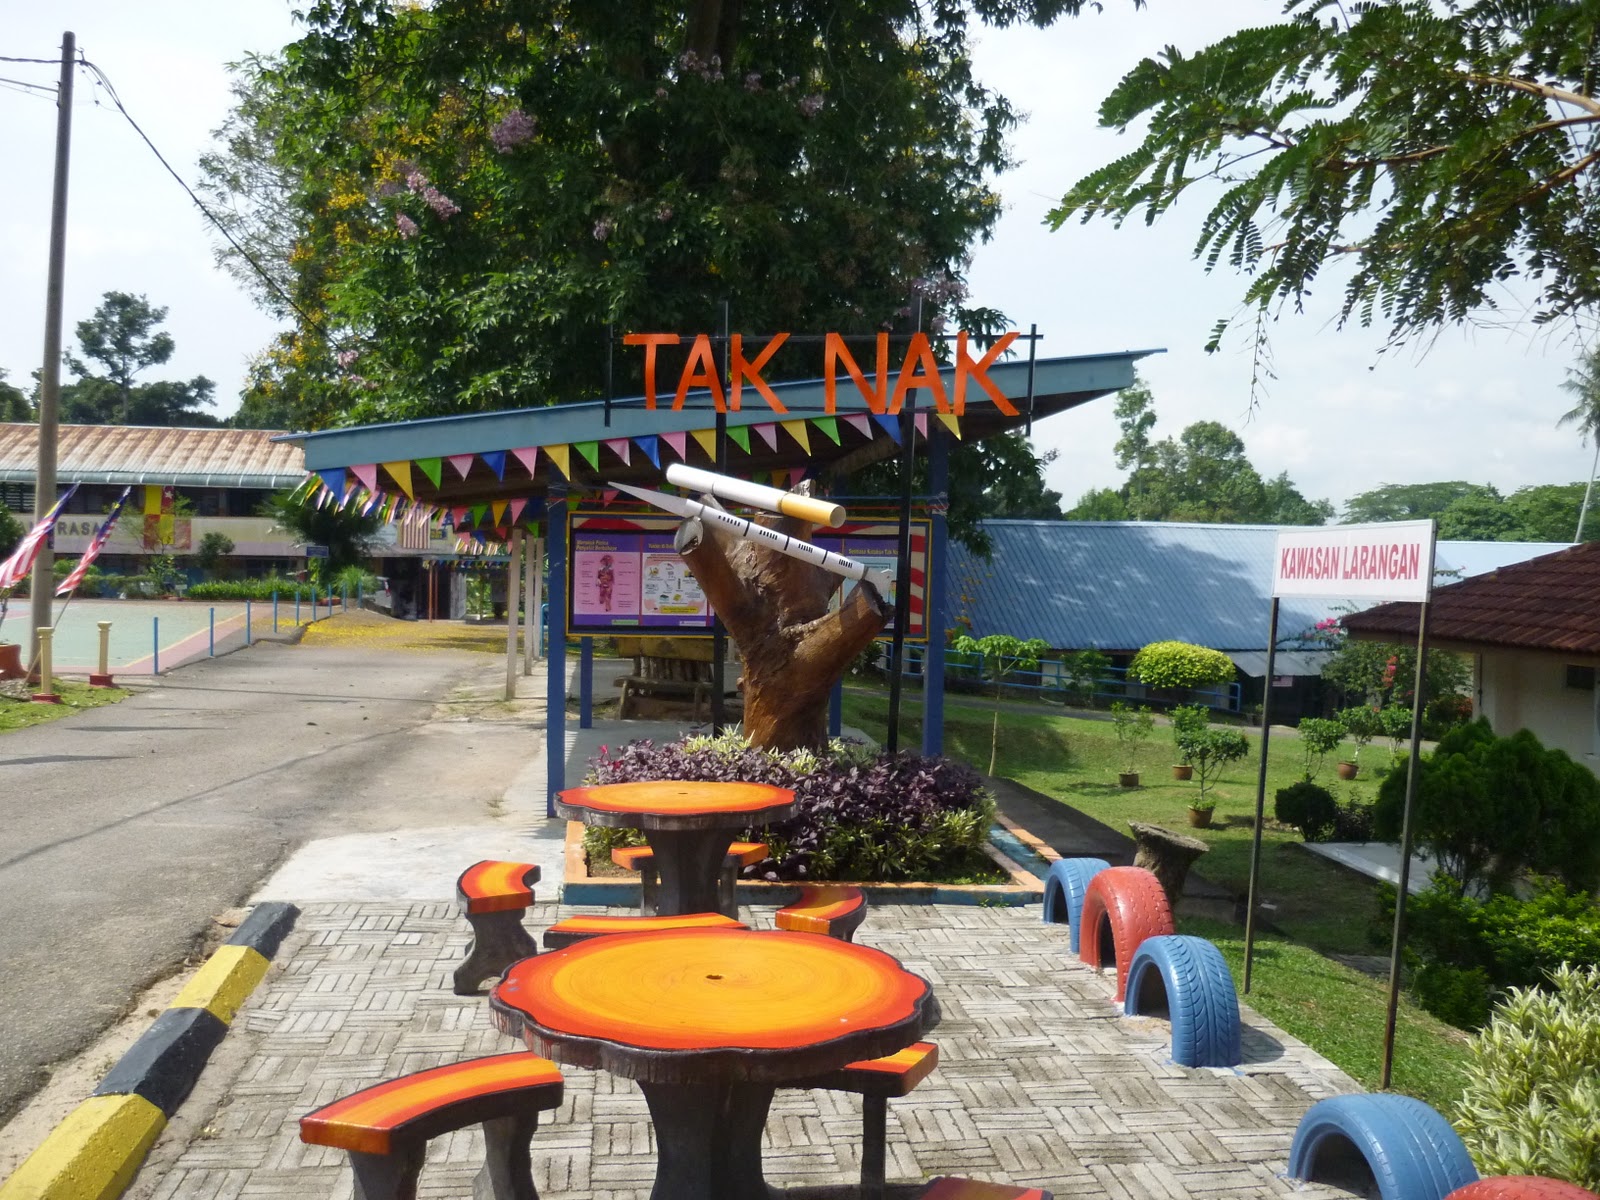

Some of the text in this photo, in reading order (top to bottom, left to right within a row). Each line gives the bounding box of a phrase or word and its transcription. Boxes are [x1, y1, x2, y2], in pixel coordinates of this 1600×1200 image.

[623, 331, 1020, 416] TAK NAK
[1280, 543, 1420, 580] KAWASAN LARANGAN
